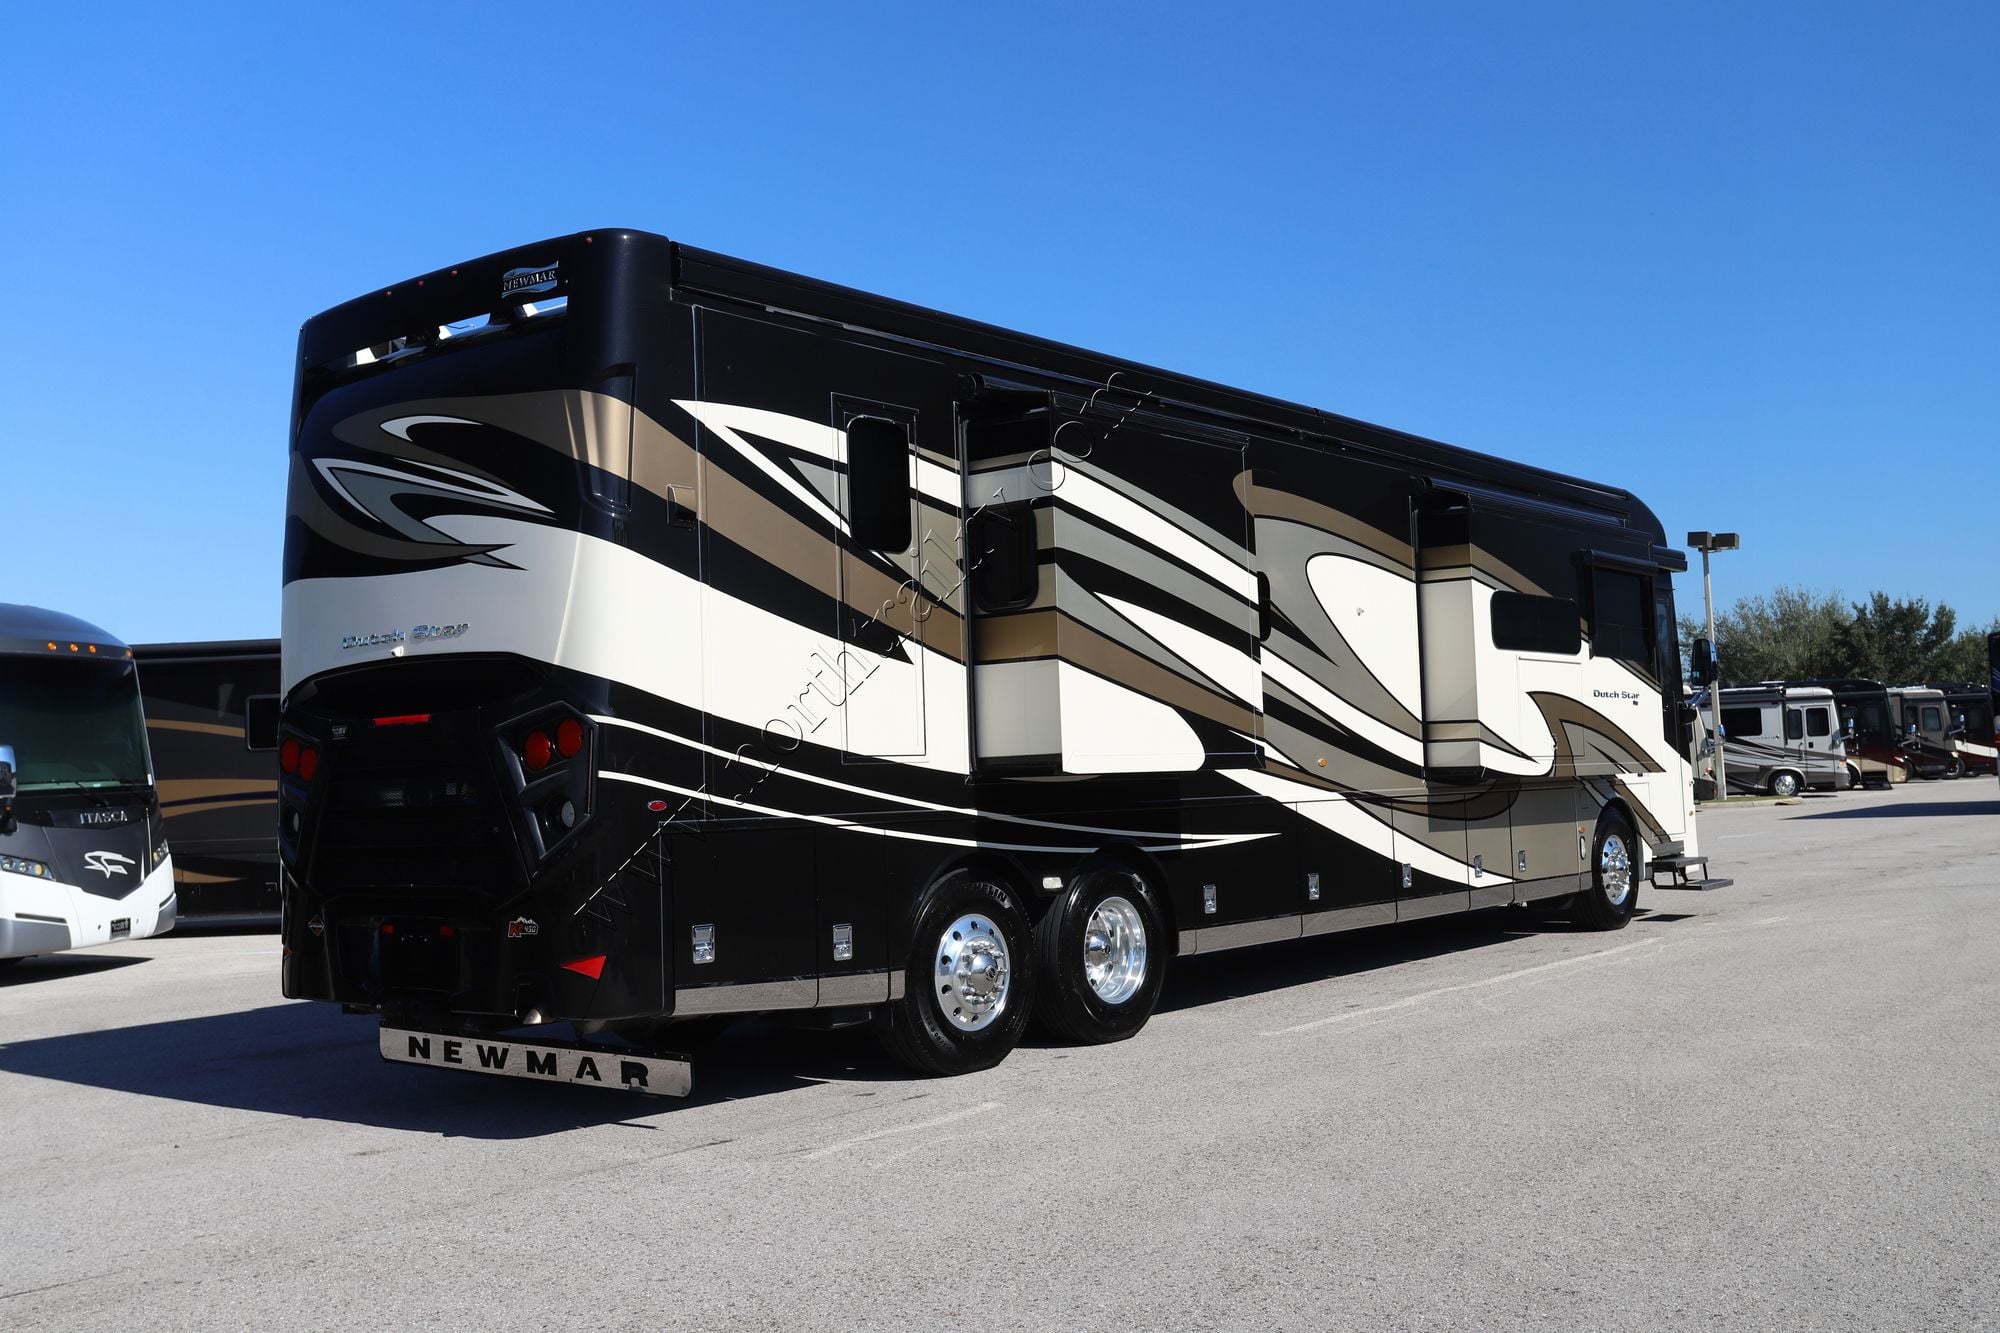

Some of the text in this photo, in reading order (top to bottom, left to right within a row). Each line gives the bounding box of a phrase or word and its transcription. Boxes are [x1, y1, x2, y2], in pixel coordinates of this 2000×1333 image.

[503, 270, 556, 291] NEWMAR
[342, 623, 470, 649] Dutch Star
[1593, 689, 1640, 699] Dutch Star
[80, 810, 128, 824] ITASCA
[408, 1035, 650, 1087] NEWMAR
